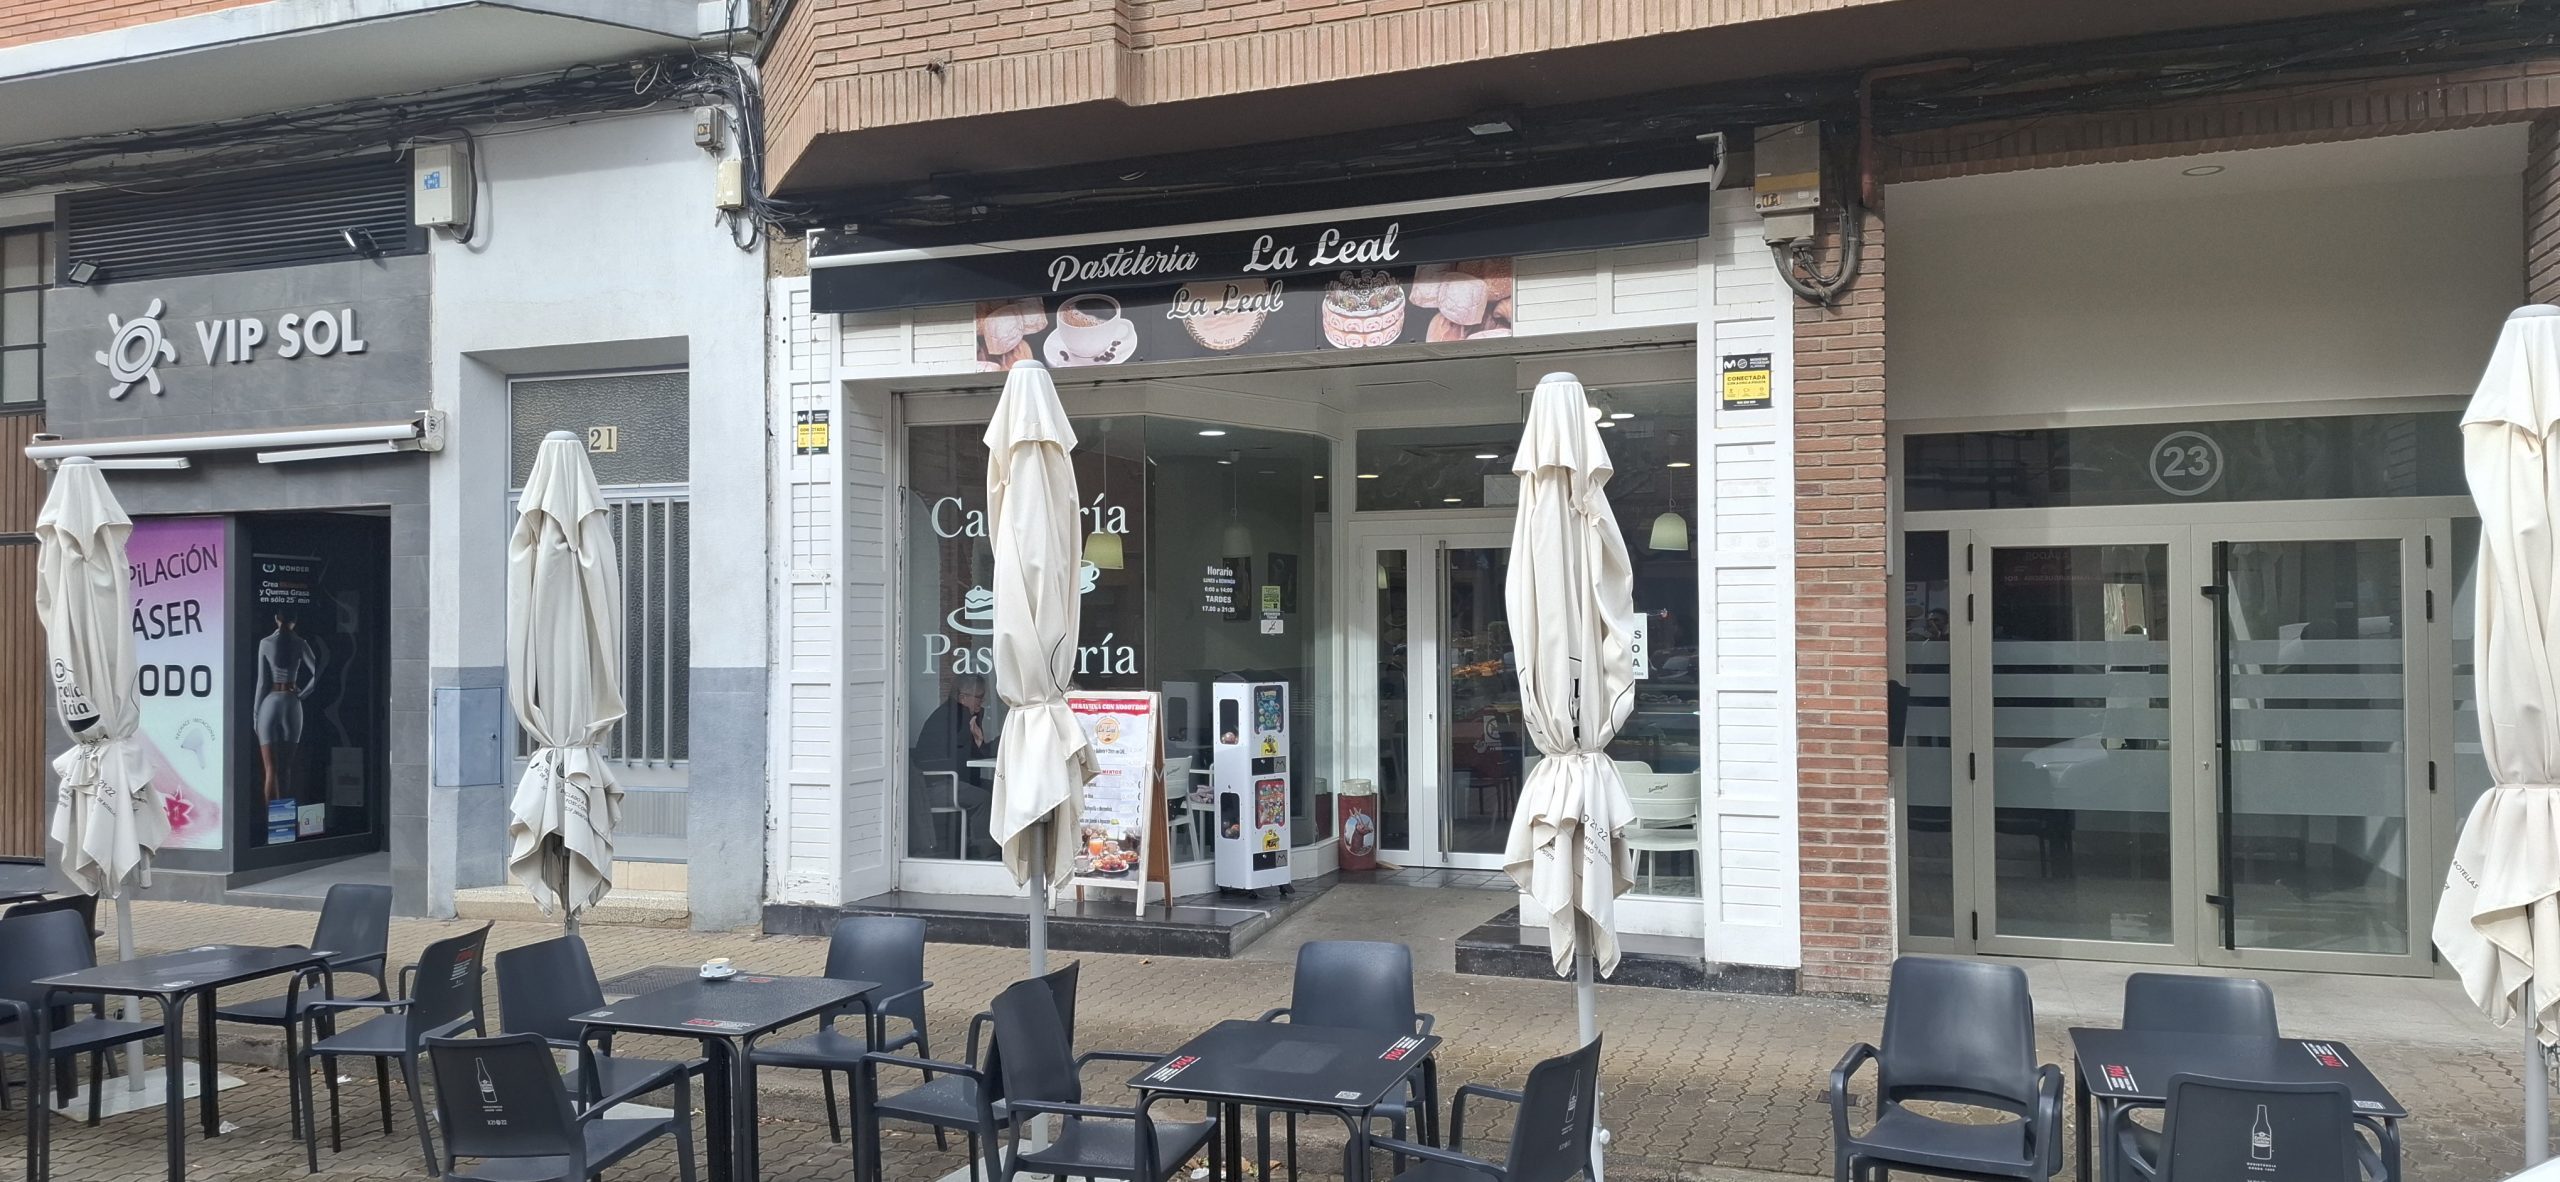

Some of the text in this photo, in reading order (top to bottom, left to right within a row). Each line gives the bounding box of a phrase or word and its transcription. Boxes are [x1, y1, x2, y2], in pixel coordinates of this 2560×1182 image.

[1243, 234, 1298, 272] La
[1308, 222, 1400, 267] Leal
[1166, 279, 1285, 320] La Leal
[195, 307, 365, 366] VIP SOL
[590, 428, 614, 450] 21
[2163, 445, 2211, 477] 23
[931, 492, 1130, 538] Caría
[1207, 565, 1233, 577] Horario
[265, 588, 289, 596] Quema
[1205, 595, 1232, 604] TARDES
[132, 598, 203, 640] ÁSER
[922, 632, 1138, 675] Pasría
[139, 664, 212, 698] ODO
